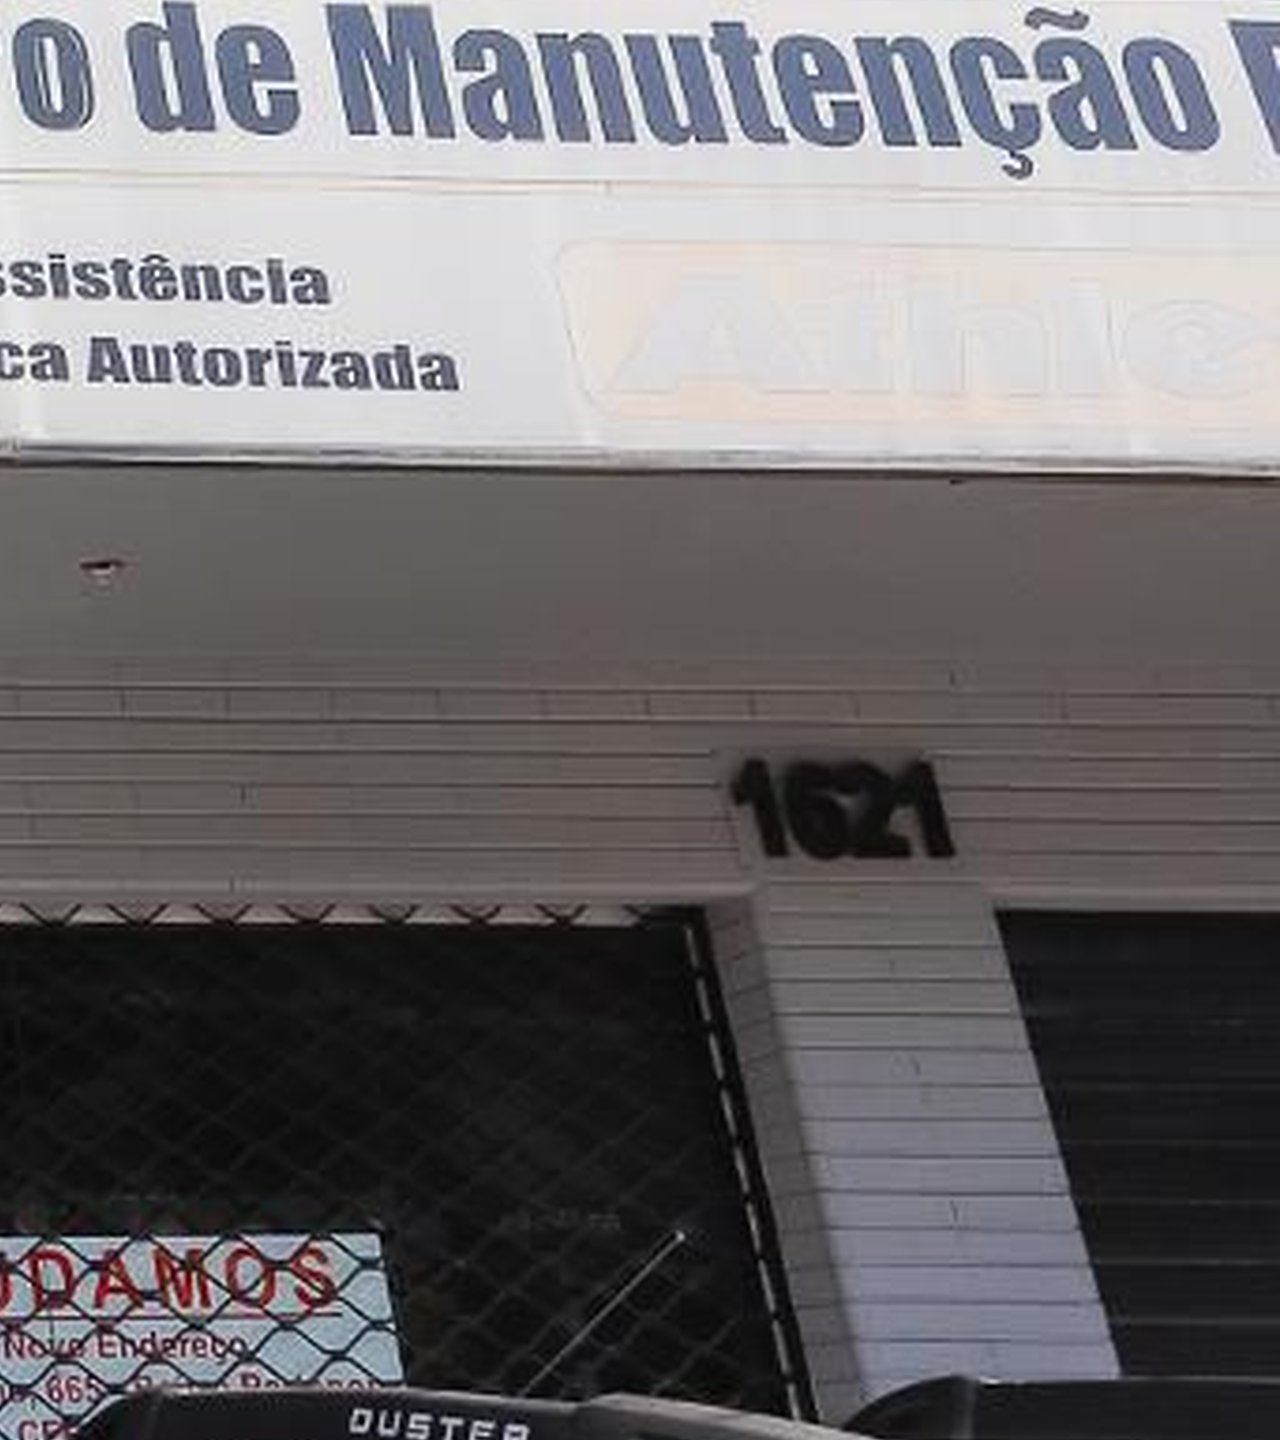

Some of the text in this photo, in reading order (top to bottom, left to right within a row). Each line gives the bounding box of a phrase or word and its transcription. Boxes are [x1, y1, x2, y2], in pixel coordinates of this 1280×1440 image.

[125, 0, 302, 137] de
[324, 2, 1222, 181] Manutenção
[85, 335, 461, 393] Autorizada
[730, 757, 956, 861] 1621
